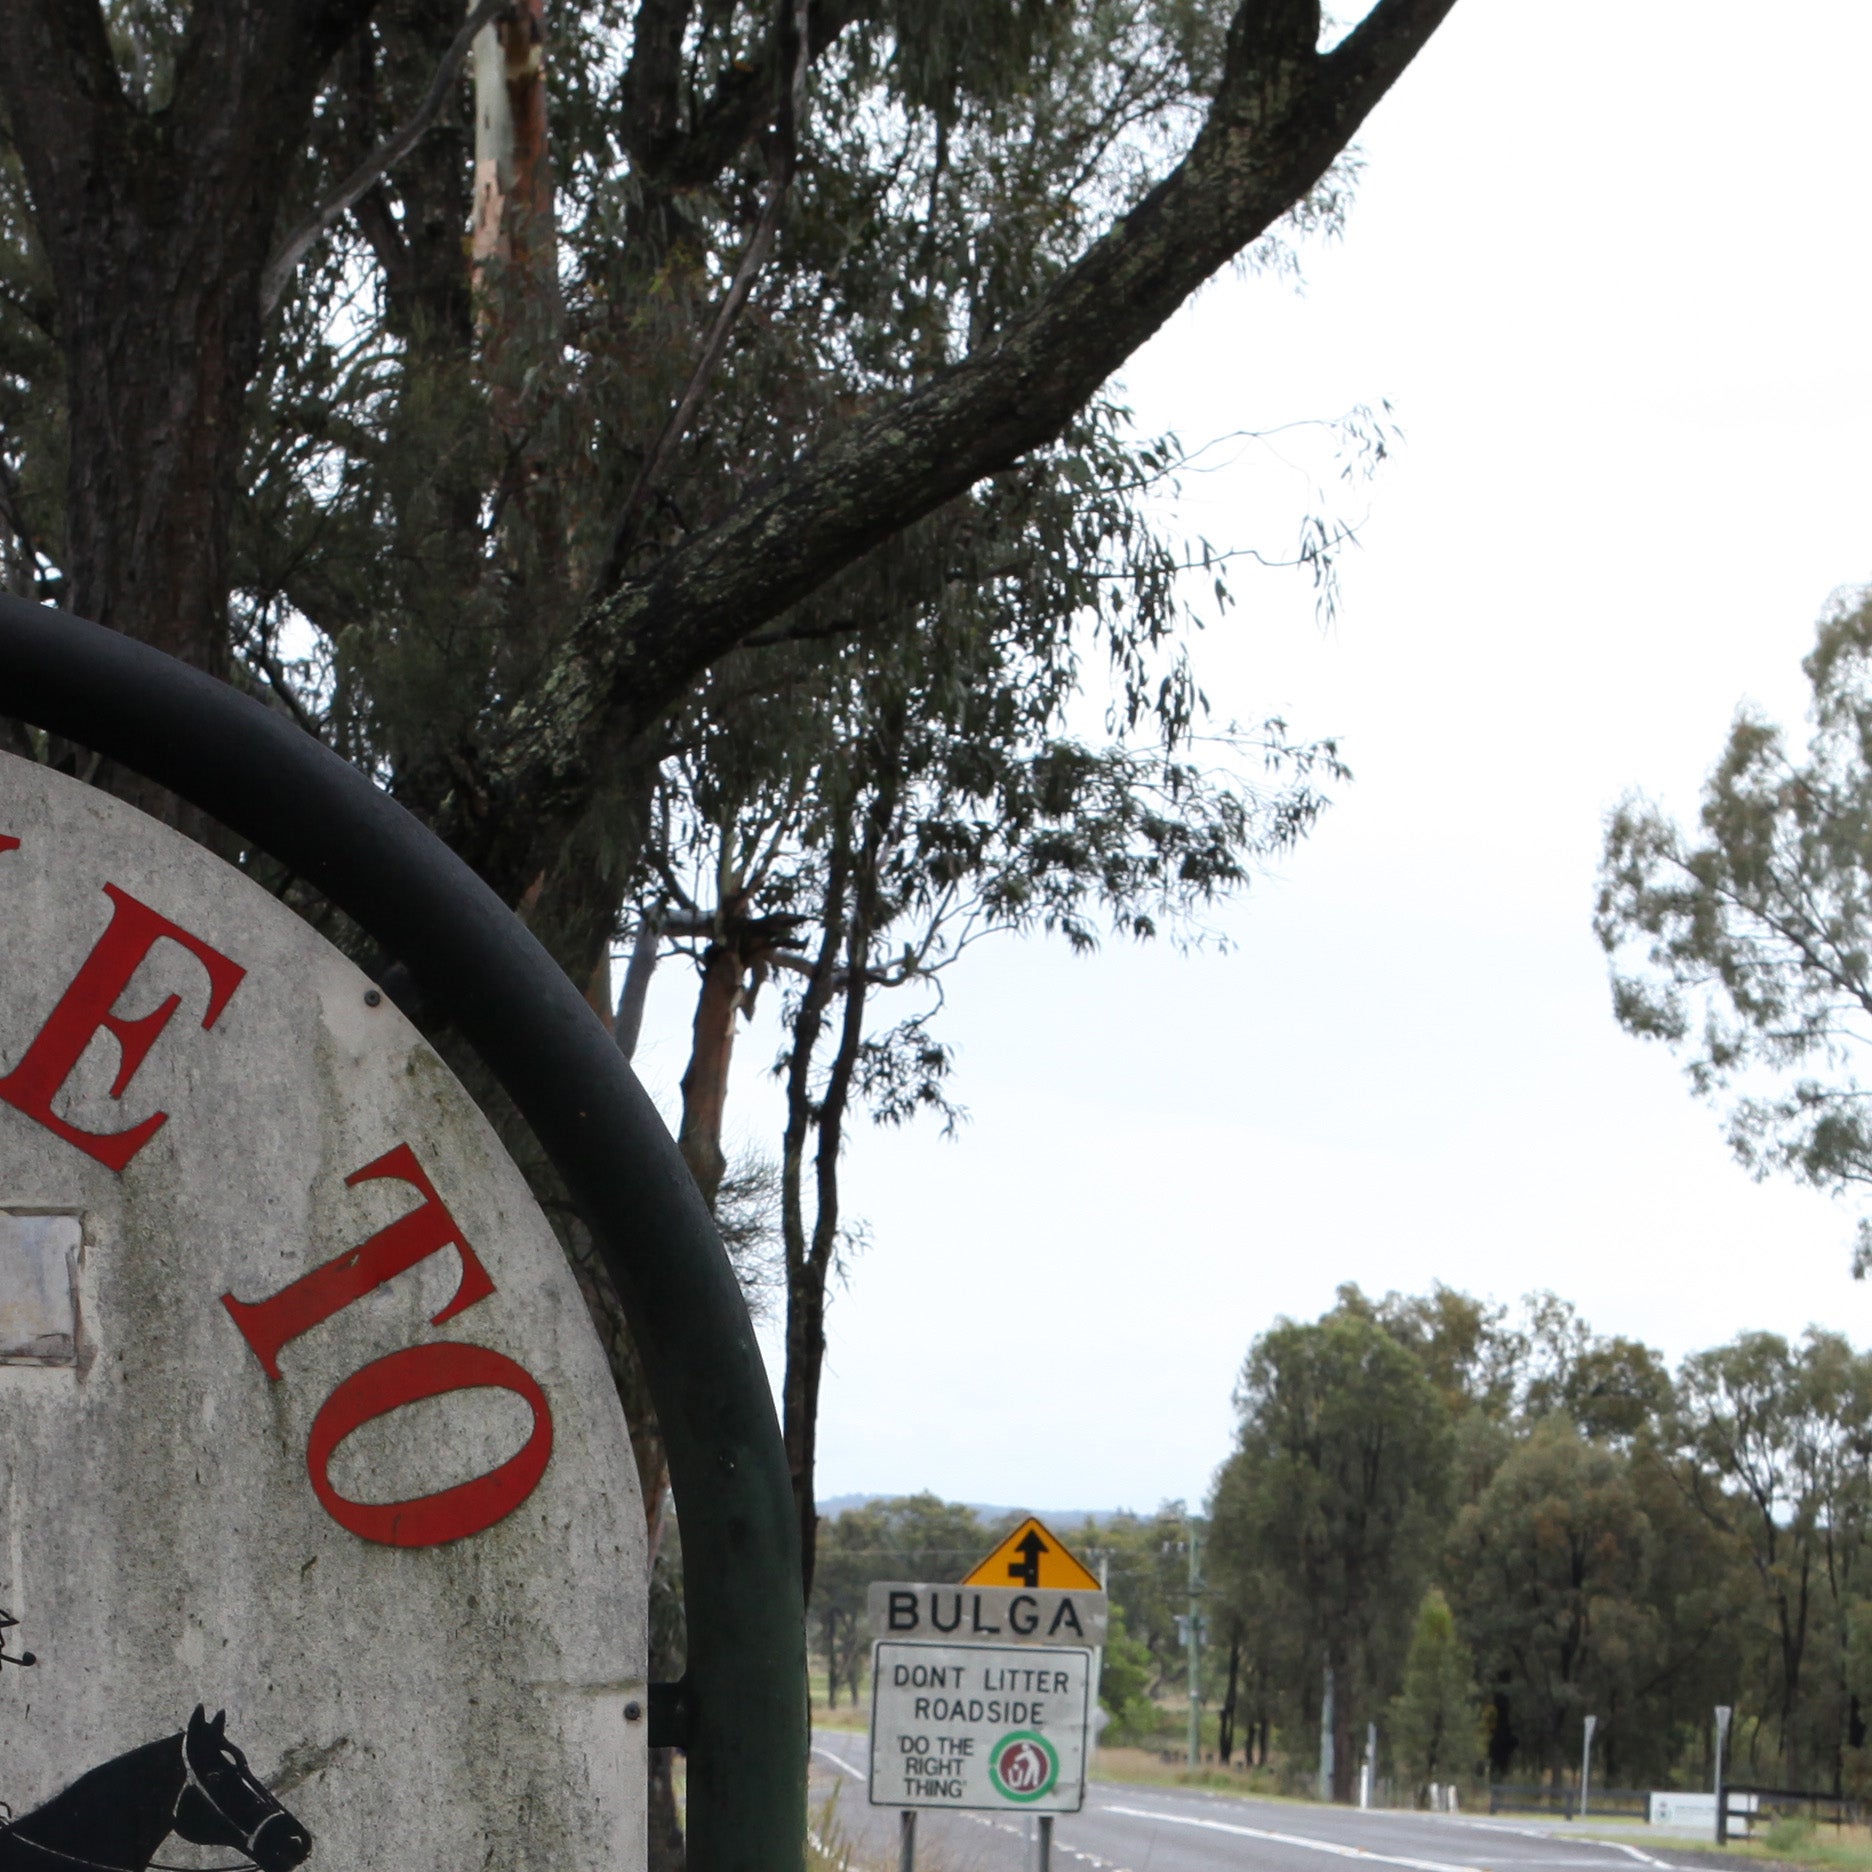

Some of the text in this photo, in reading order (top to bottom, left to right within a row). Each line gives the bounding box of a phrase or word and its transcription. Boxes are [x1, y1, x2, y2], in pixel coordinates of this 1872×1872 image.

[222, 1142, 553, 1547] TO
[888, 1591, 1083, 1637] BULGA
[984, 1668, 1069, 1693] LITTER
[915, 1697, 1044, 1724] ROADSIDE
[938, 1736, 974, 1756] THE
[906, 1757, 963, 1775] RIGHT
